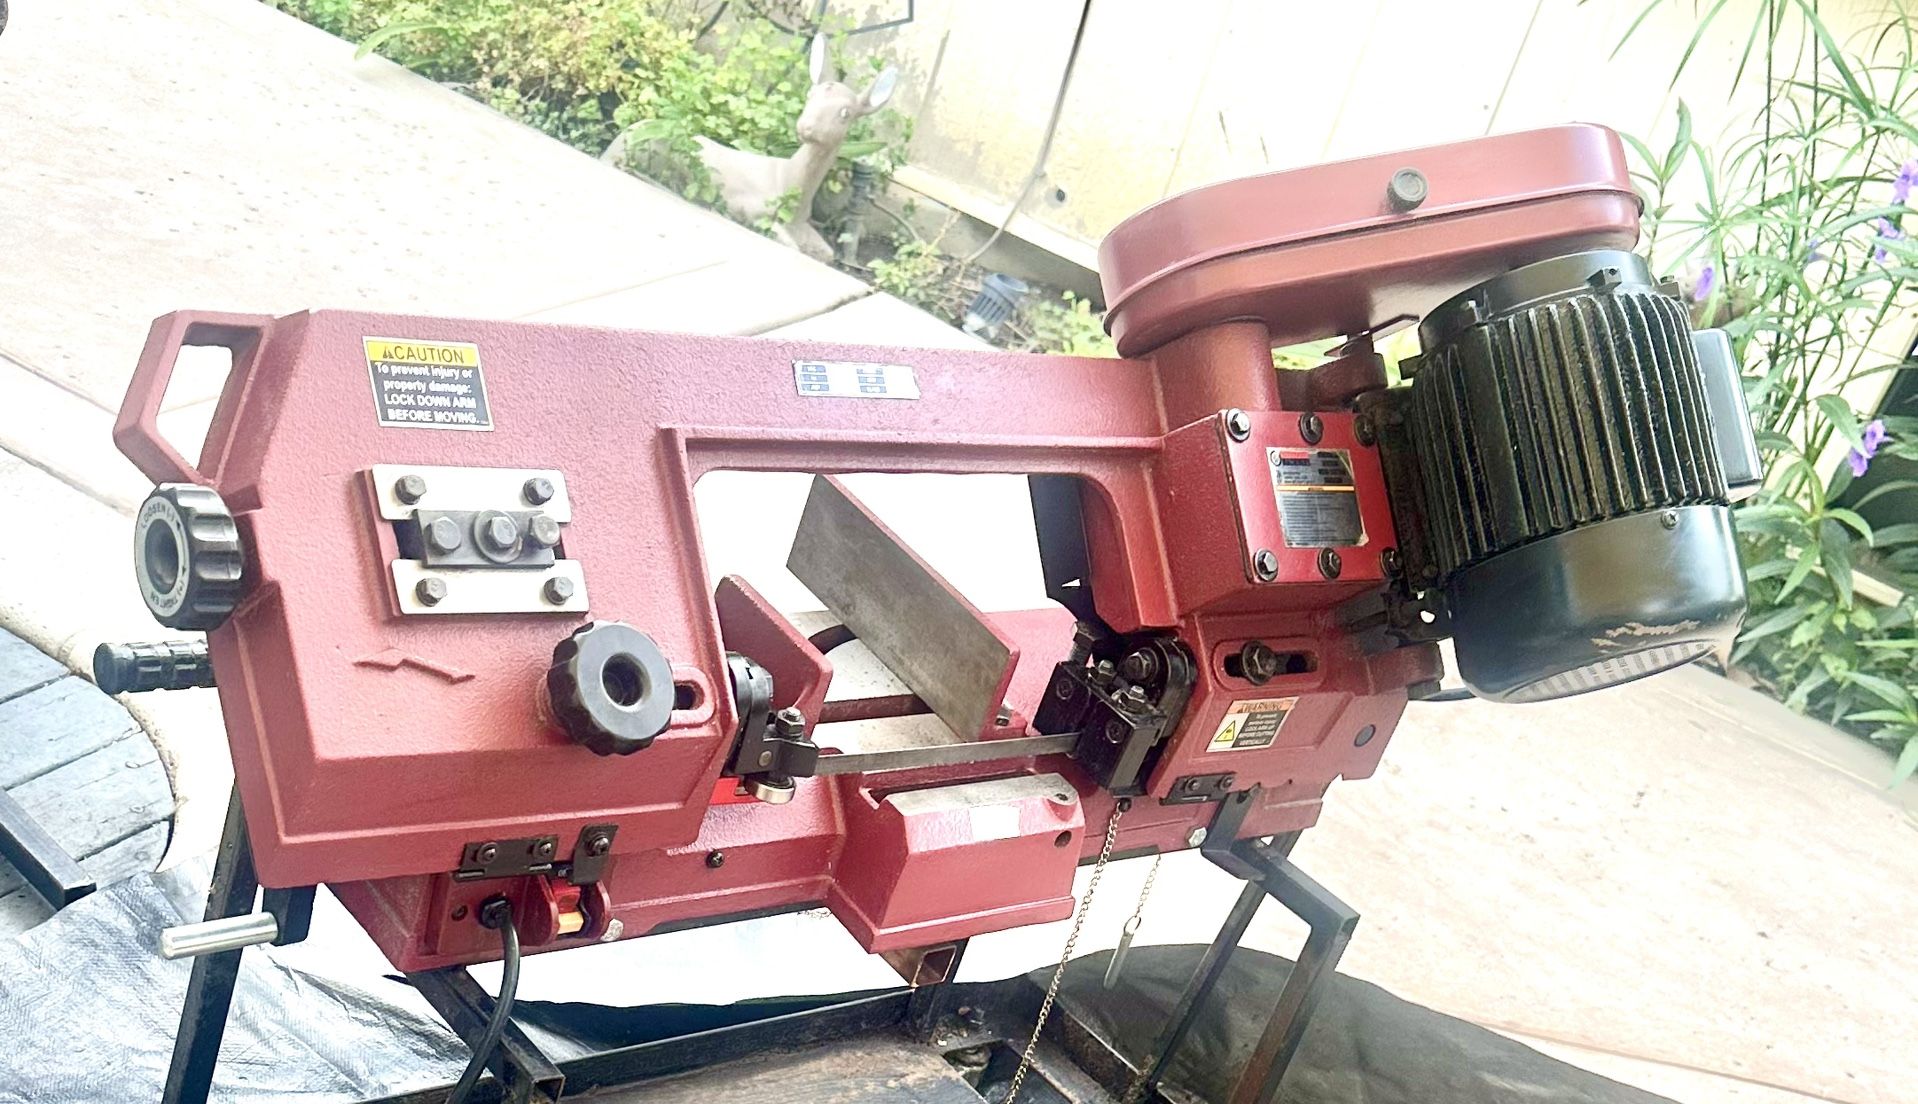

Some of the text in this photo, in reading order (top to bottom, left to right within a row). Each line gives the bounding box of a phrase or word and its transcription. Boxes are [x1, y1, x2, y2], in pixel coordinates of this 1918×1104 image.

[394, 345, 464, 363] CAUTION
[375, 362, 473, 380] To prevent injury or
[384, 380, 472, 395] property damage:
[384, 393, 477, 409] LOCK DOWN ARM
[388, 408, 480, 424] BEFORE MOVING.
